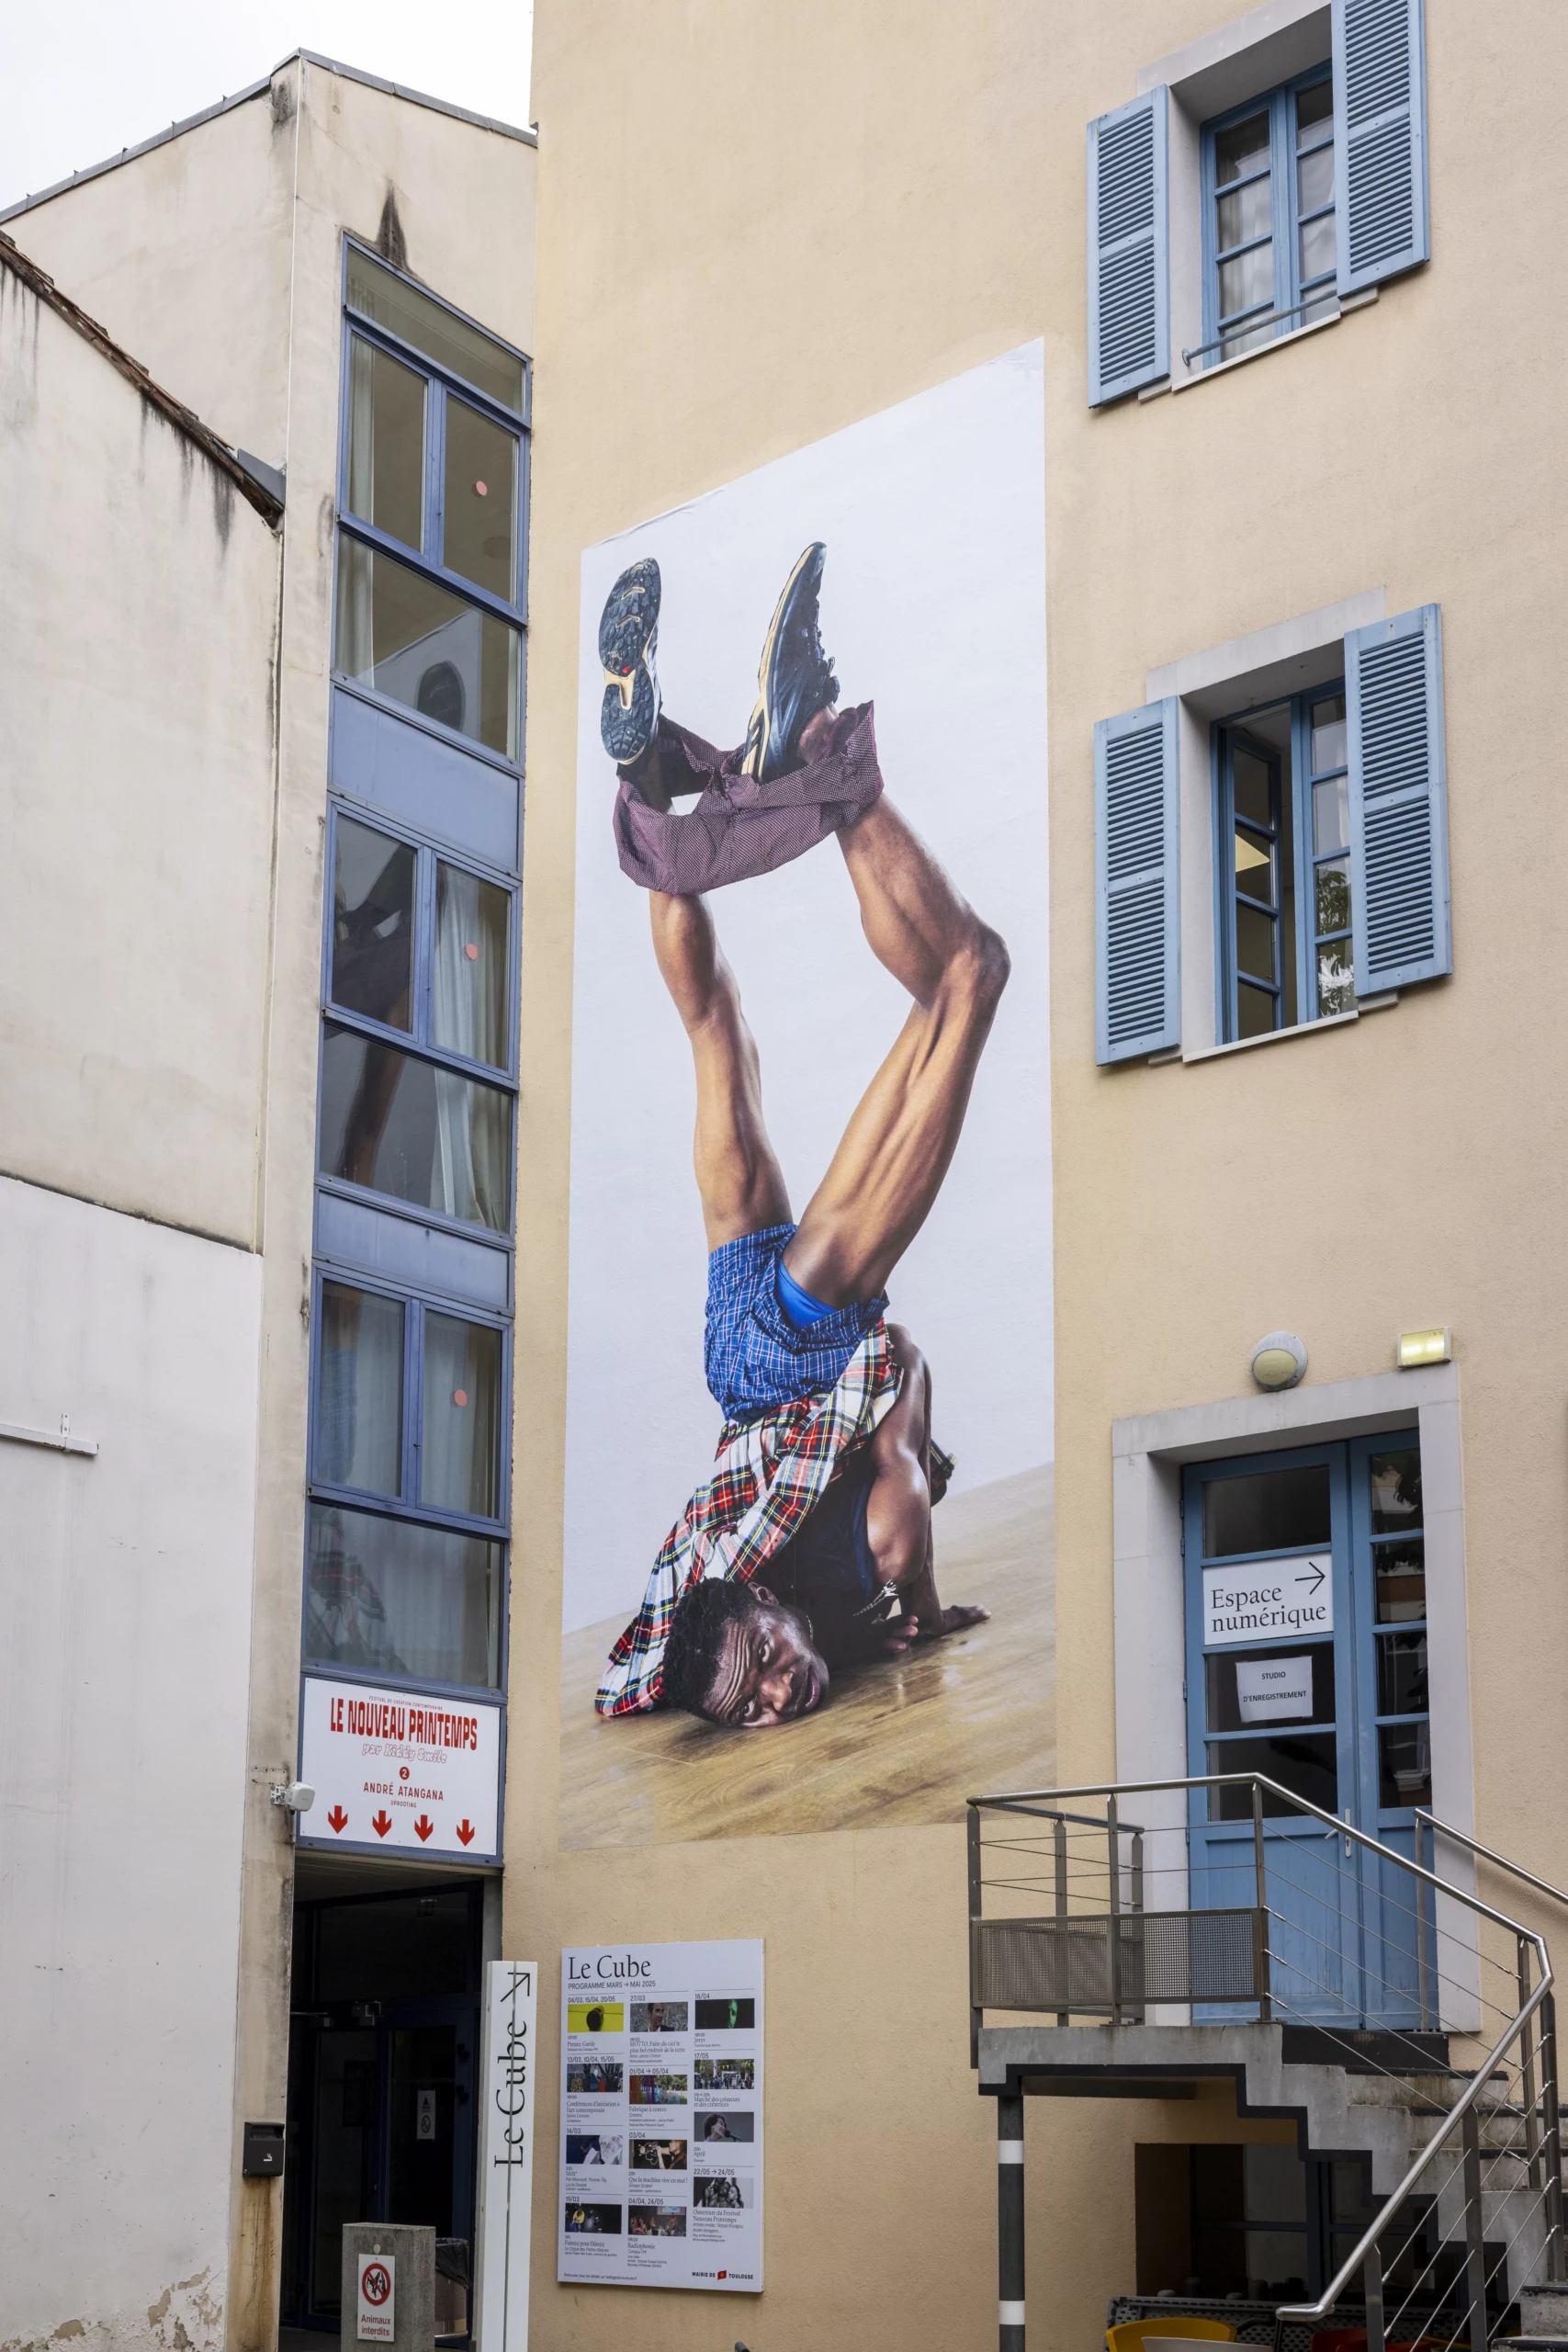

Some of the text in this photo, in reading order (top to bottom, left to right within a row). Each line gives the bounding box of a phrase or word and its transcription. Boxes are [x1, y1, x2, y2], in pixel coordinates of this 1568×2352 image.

[1211, 1587, 1282, 1612] Espace
[1211, 1605, 1326, 1633] numérique
[1261, 1670, 1286, 1680] STUDIO
[412, 1702, 444, 1712] CONTEMPORAINE
[331, 1697, 478, 1751] LE NOUVEAU PRINTEMPS
[361, 1743, 447, 1764] par Kiddy Smile
[364, 1781, 445, 1801] ANDRÉ ATANGANA
[390, 1800, 417, 1809] UPROOTING
[568, 1954, 651, 1979] Le Cube
[568, 1982, 605, 1990] PROGRAMME
[494, 2020, 527, 2168] Le Cube
[361, 2314, 391, 2324] Animaux
[362, 2326, 389, 2335] interdits
